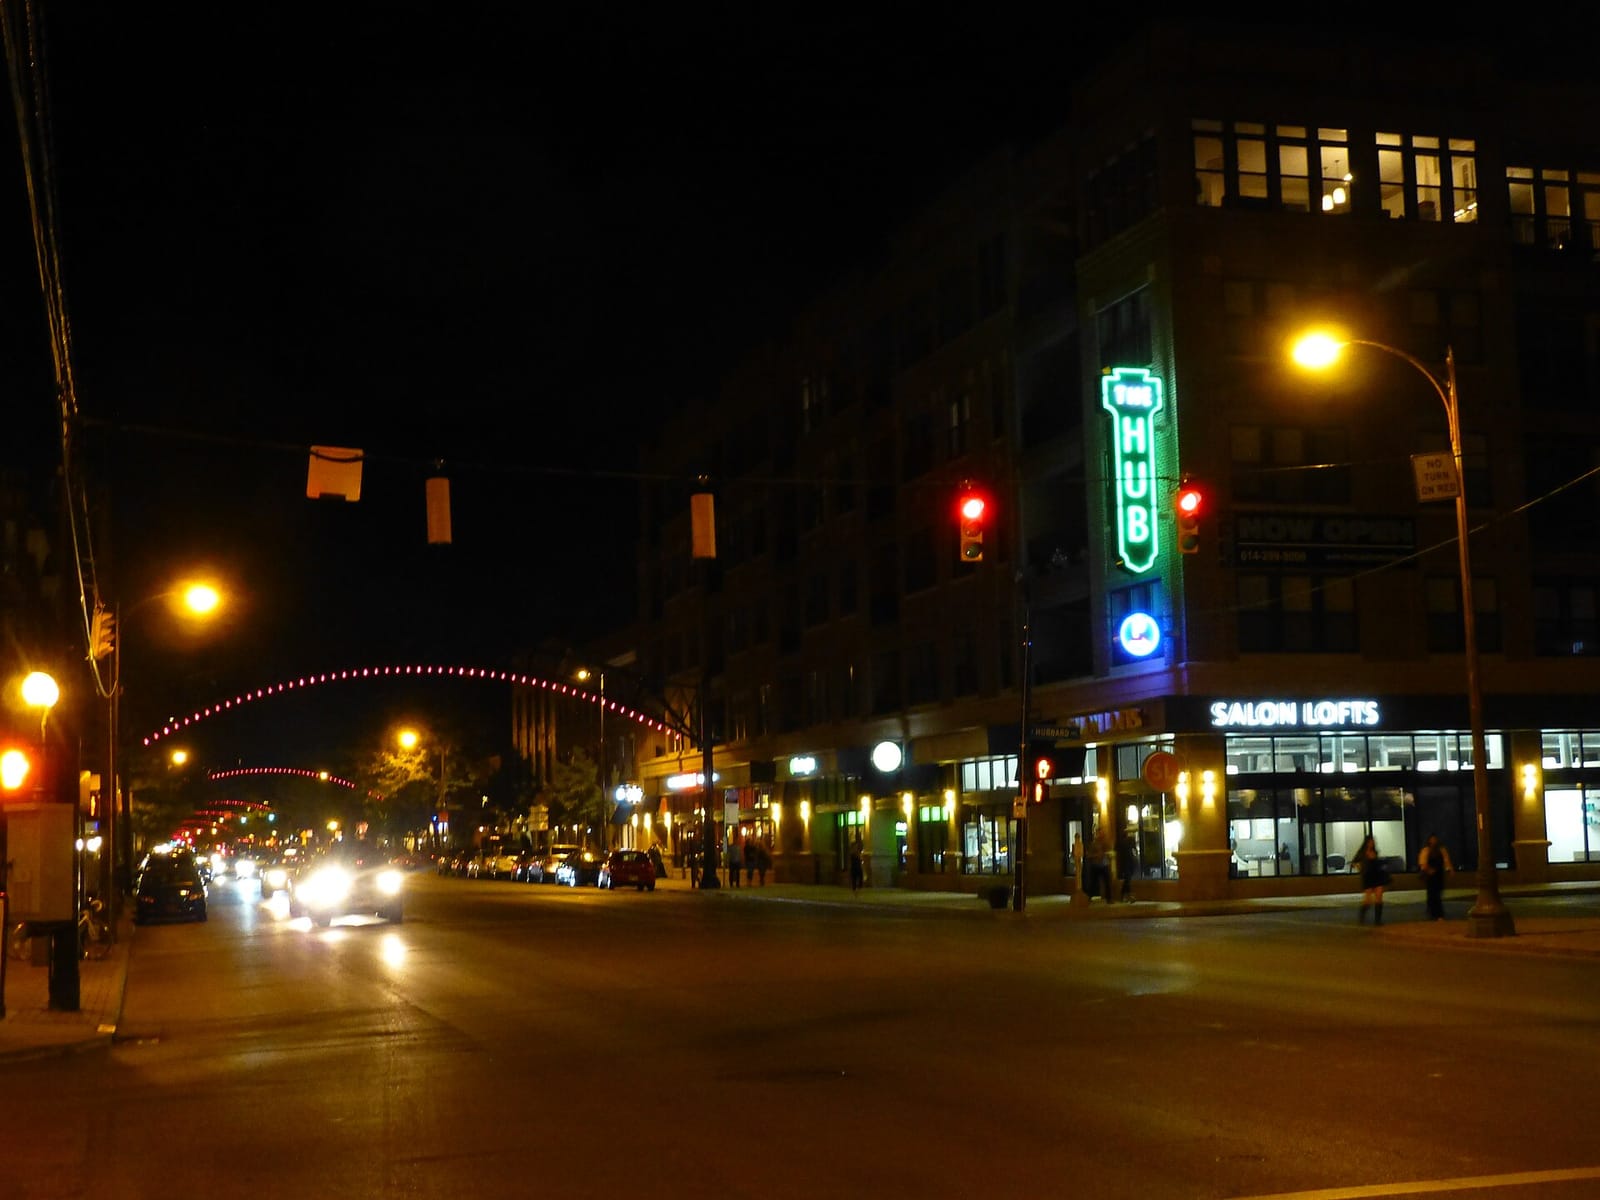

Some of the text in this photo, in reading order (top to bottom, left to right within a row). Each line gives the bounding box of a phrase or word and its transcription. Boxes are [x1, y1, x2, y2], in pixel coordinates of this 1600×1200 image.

[1114, 385, 1152, 406] THE
[1426, 458, 1442, 468] NO
[1122, 416, 1149, 543] HUB
[1424, 471, 1449, 481] TURN
[1421, 482, 1457, 495] ON RED
[1239, 518, 1414, 545] NOW OPEN
[1210, 700, 1380, 726] SALON LOFTS
